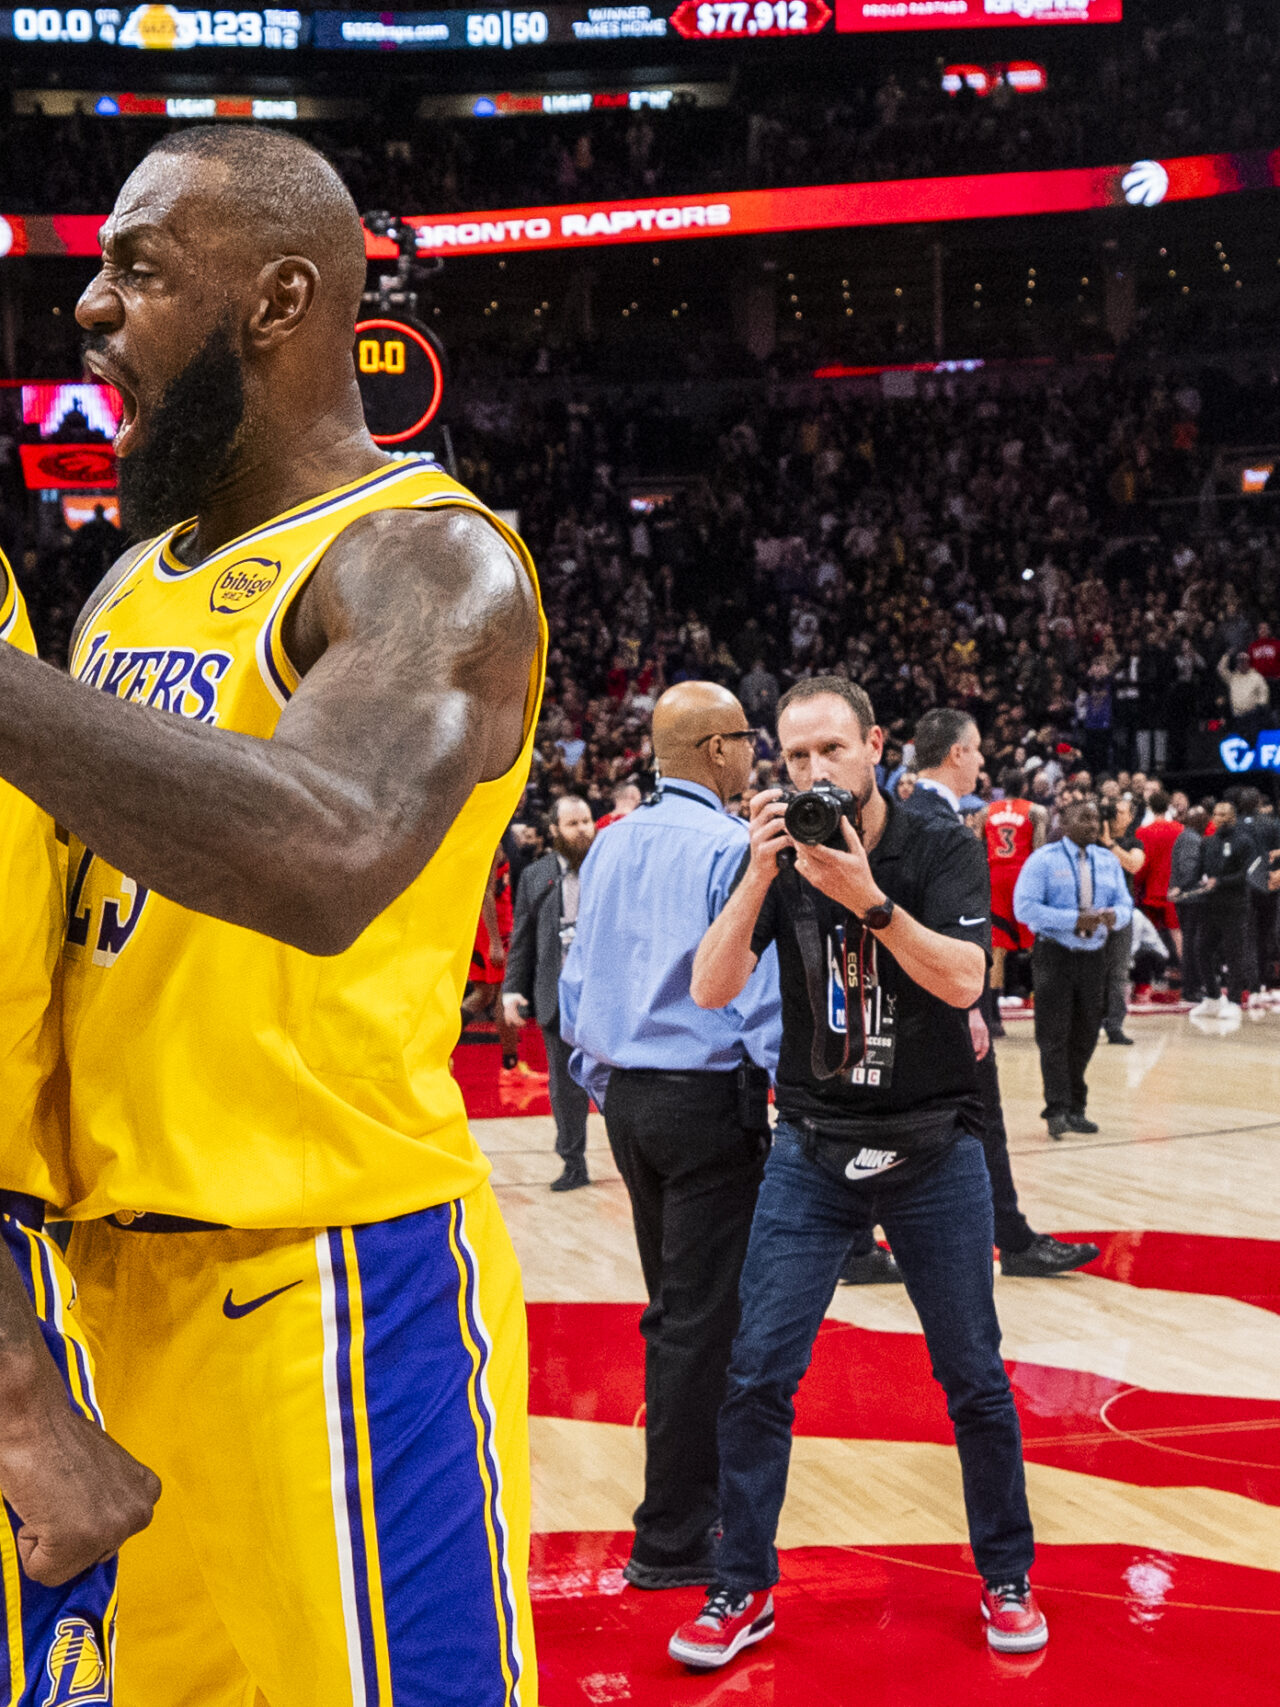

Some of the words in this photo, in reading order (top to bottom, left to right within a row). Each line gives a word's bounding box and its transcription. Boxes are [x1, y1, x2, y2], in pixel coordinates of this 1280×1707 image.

[13, 8, 92, 42] 00.0
[194, 10, 263, 47] 123
[572, 21, 622, 38] TAKES
[623, 18, 667, 37] HOME
[588, 6, 651, 22] WINNER
[697, 1, 807, 36] $77,912
[415, 216, 552, 249] ORONTO
[561, 204, 731, 238] RAPTORS
[359, 339, 405, 375] 0.0
[220, 571, 272, 598] bibigo
[994, 825, 1017, 859] 3
[847, 951, 859, 988] EOS
[855, 1147, 897, 1169] NIKE
